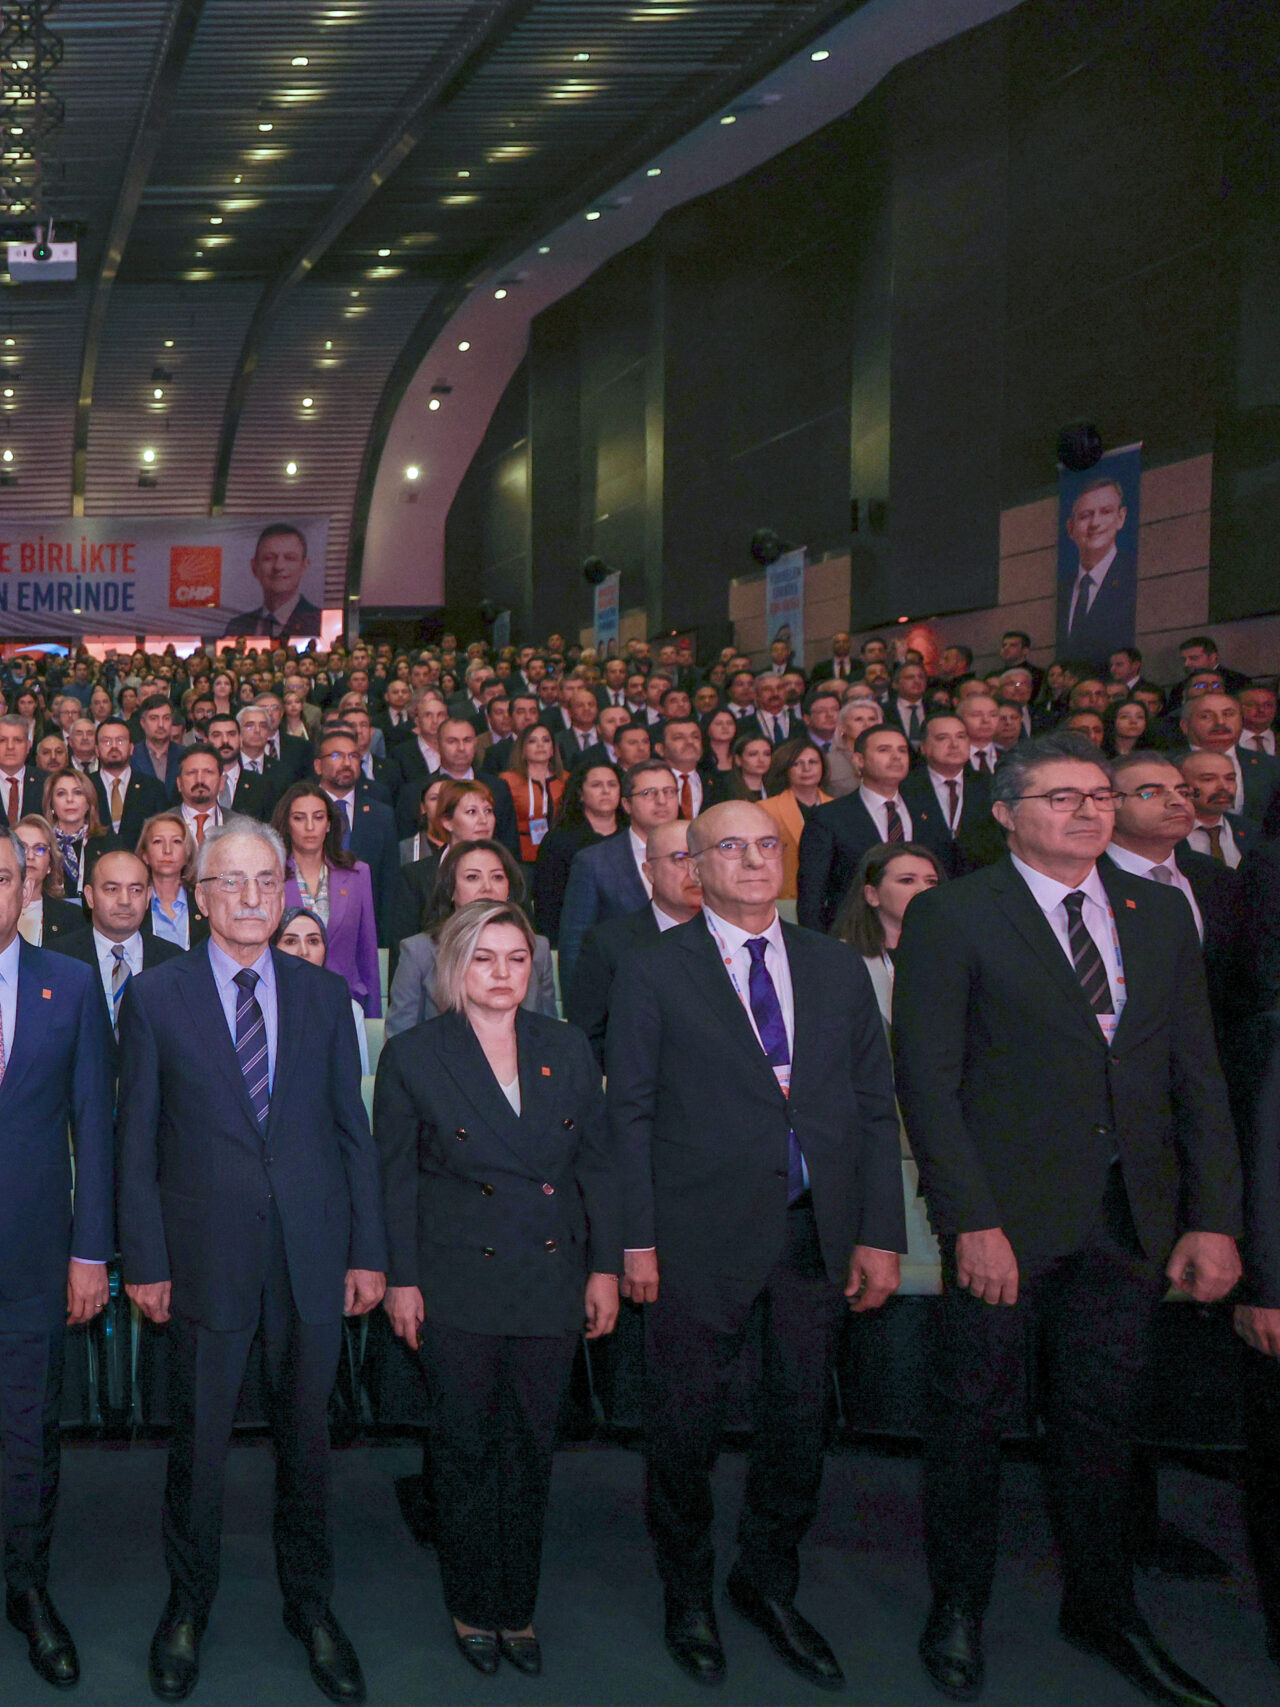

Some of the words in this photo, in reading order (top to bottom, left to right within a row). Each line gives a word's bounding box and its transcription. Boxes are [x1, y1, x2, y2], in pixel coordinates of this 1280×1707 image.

[20, 536, 136, 574] BİRLİKTE
[17, 574, 135, 612] EMRİNDE
[176, 586, 214, 601] CHP
